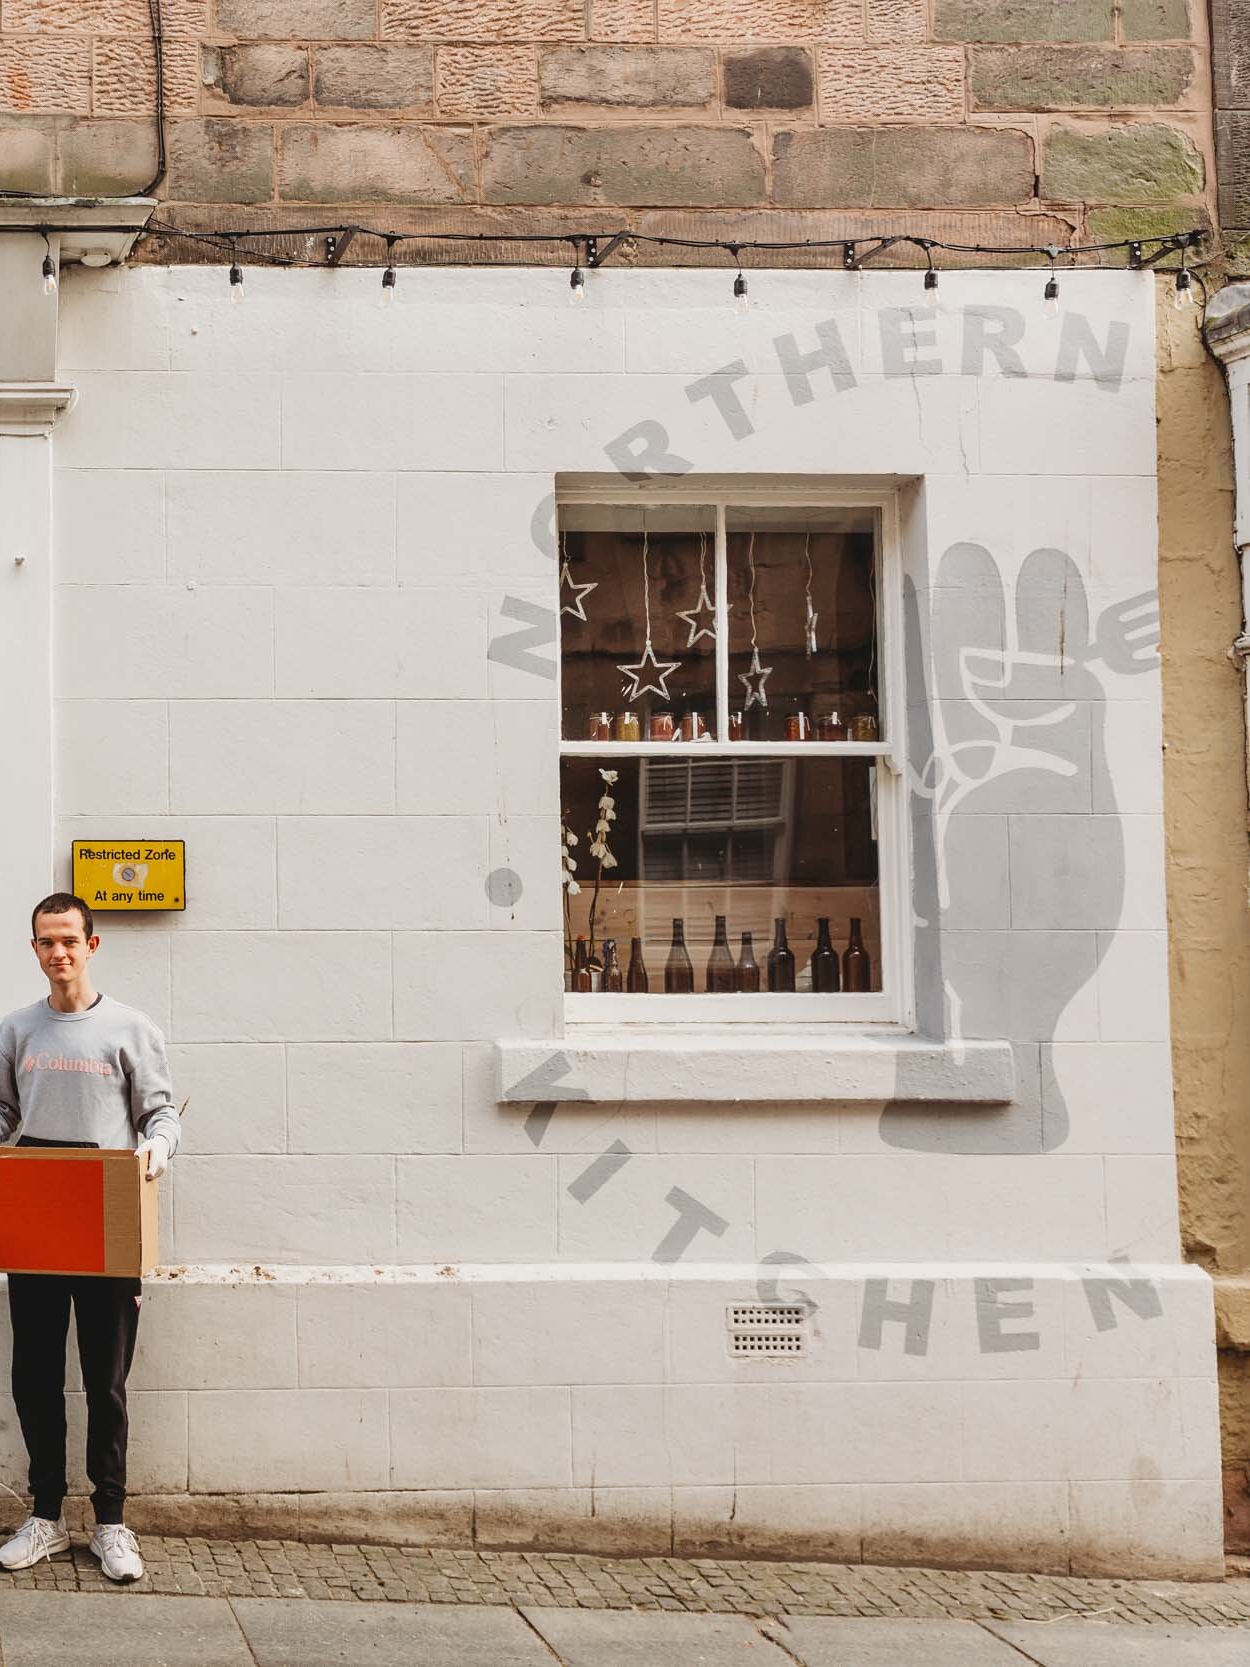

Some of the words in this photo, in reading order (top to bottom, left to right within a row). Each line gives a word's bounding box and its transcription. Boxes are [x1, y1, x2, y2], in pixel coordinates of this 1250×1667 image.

[79, 848, 141, 861] Restricted
[144, 848, 176, 861] Zone
[94, 891, 107, 902] At
[111, 892, 133, 904] any
[137, 890, 165, 902] time
[36, 1051, 112, 1076] Columbia
[503, 1051, 1164, 1357] KITCHEN
